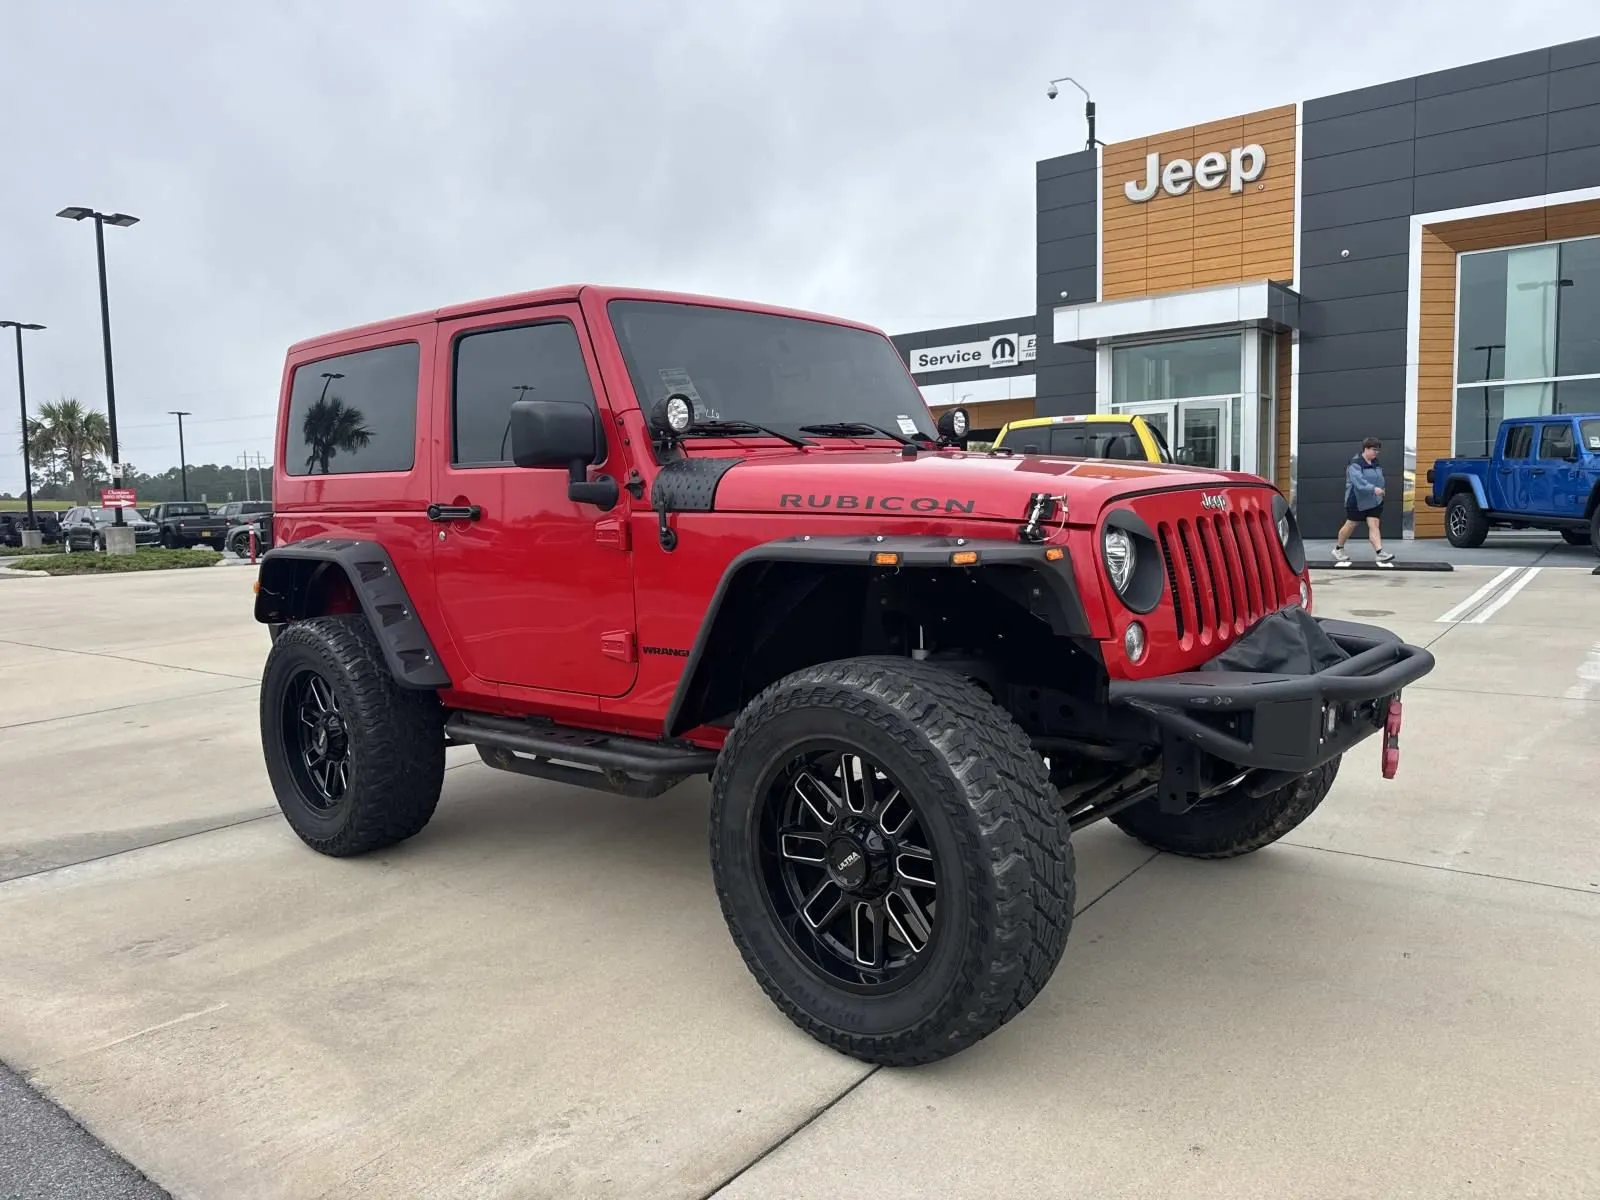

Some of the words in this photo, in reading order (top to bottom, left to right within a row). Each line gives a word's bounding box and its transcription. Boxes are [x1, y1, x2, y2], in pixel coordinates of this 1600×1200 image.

[1124, 144, 1266, 203] Jeep
[918, 350, 982, 367] Service
[779, 494, 976, 514] RUBICON
[1202, 492, 1226, 511] Jeep
[838, 851, 860, 871] ULTRA
